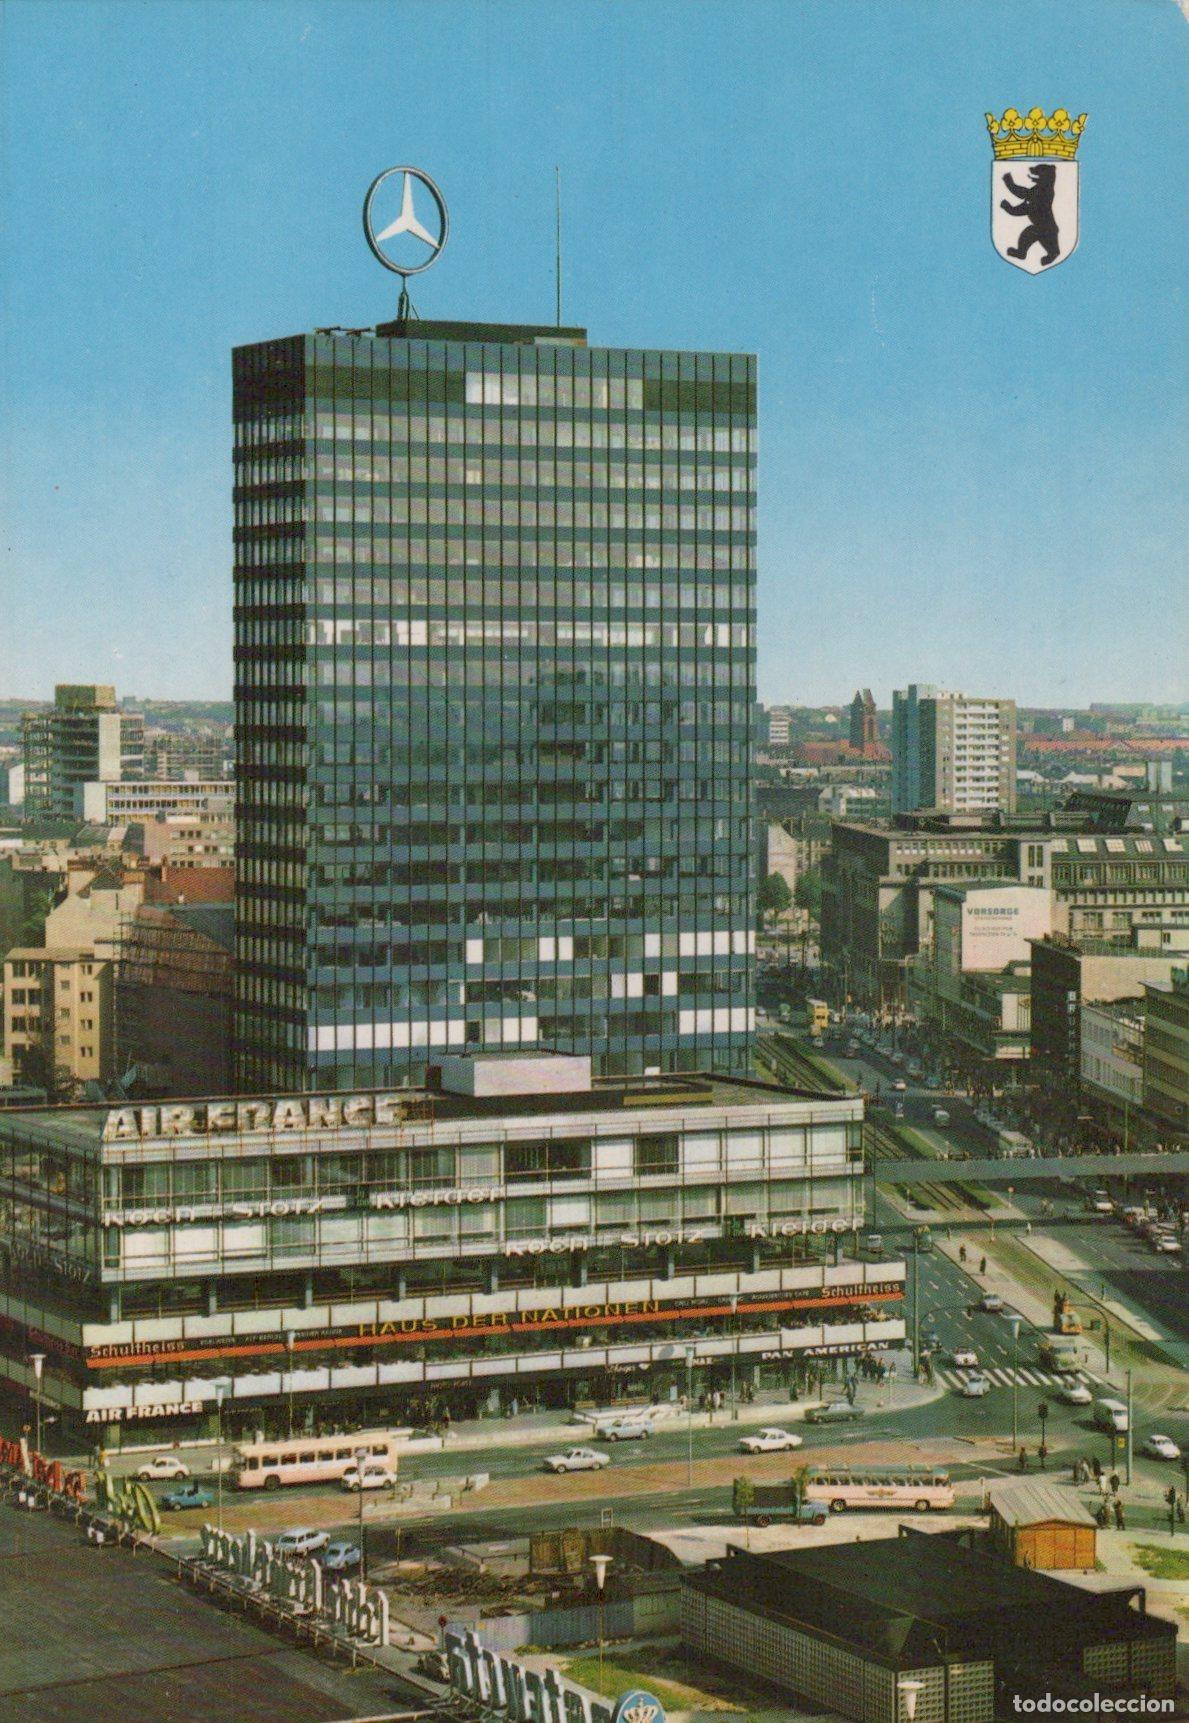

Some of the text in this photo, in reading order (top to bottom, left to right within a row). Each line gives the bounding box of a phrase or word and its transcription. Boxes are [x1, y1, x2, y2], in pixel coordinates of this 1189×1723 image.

[102, 1104, 195, 1141] AIR
[821, 1282, 901, 1298] Schultheiss
[358, 1319, 438, 1337] HAUS
[452, 1311, 508, 1329] DER
[521, 1300, 660, 1324] NATIONEN
[91, 1341, 185, 1358] Schultheiss
[761, 1342, 889, 1361] PAN AMERICAN
[86, 1401, 202, 1424] AIR FRANCE
